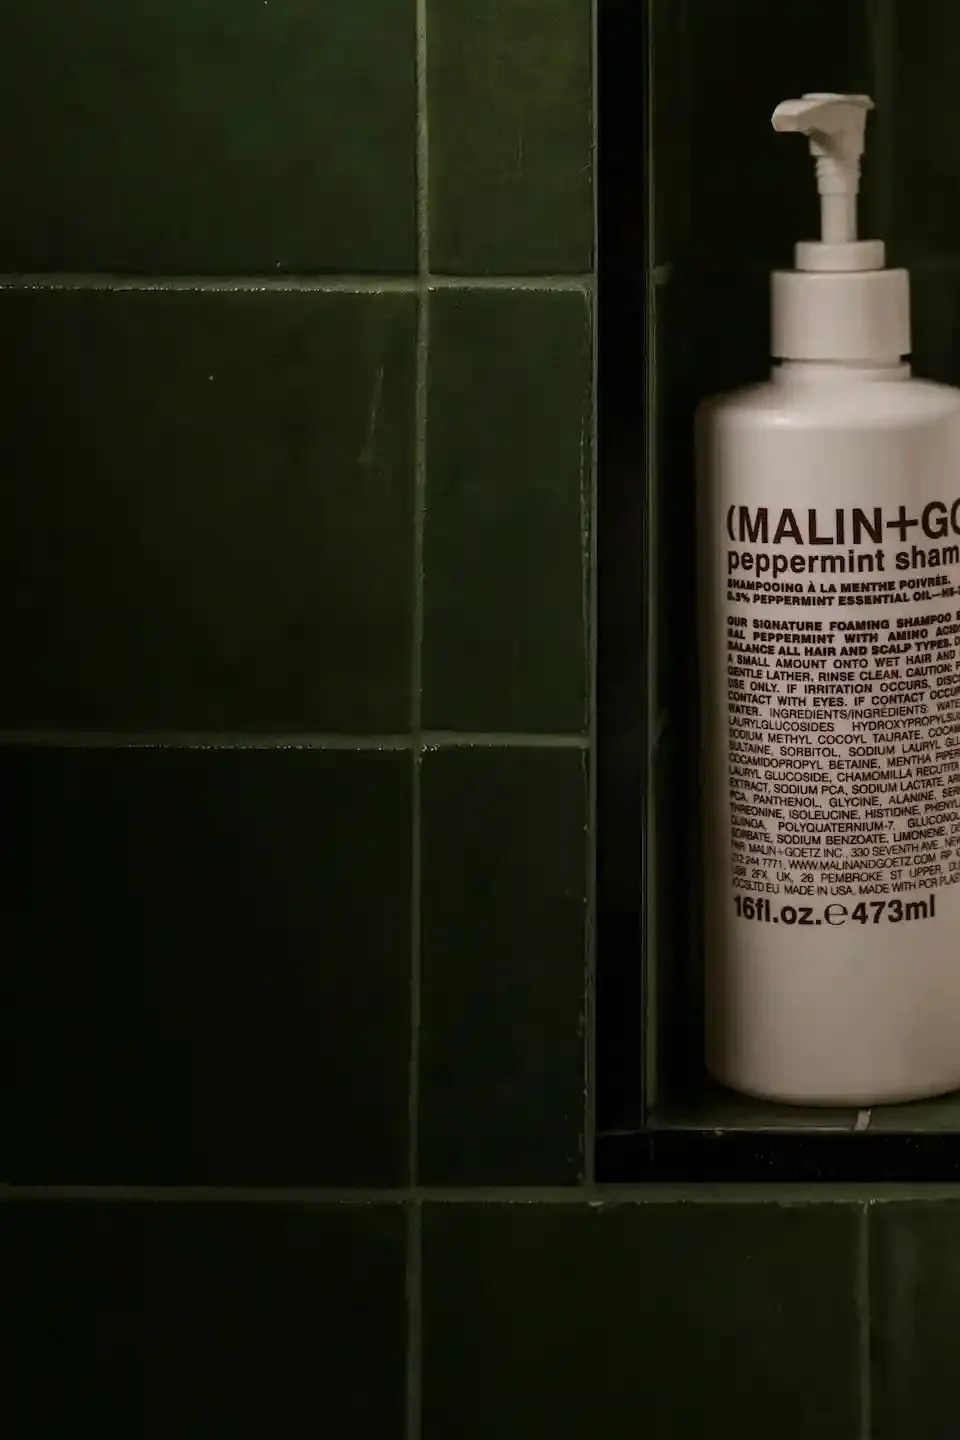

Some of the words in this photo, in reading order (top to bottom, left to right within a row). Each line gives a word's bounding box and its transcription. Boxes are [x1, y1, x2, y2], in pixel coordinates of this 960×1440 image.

[728, 549, 884, 578] peppermint
[820, 583, 837, 593] LA
[841, 581, 896, 593] MENTHE
[754, 594, 833, 607] PEPPERMINT
[839, 593, 909, 606] ESSENTIAL
[728, 616, 747, 627] OUR
[753, 619, 822, 631] SIGNATURE
[829, 620, 889, 631] FOAMING
[897, 612, 951, 628] SHAMPOO
[753, 632, 835, 644] PEPPERMINT
[845, 633, 878, 643] WITH
[888, 629, 928, 641] AMINO
[778, 646, 800, 656] ALL
[805, 646, 836, 656] HAIR
[840, 646, 868, 656] AND
[872, 643, 911, 655] SCALP
[737, 655, 770, 667] SMALL
[776, 659, 827, 669] AMOUNT
[834, 658, 868, 669] ONTO
[875, 657, 900, 667] WET
[906, 654, 931, 665] HAIR
[818, 672, 855, 681] RINSE
[860, 670, 902, 680] CLEAN.
[750, 681, 780, 693] ONLY.
[787, 684, 796, 694] IF
[804, 683, 872, 694] IRRITATION
[778, 696, 806, 707] WITH
[813, 697, 848, 707] EYES.
[855, 696, 864, 706] IF
[872, 691, 924, 705] CONTACT
[768, 732, 811, 744] METHYL
[817, 735, 867, 744] COCOYL
[849, 746, 894, 757] SODIUM
[902, 740, 941, 754] LAURYL
[887, 755, 931, 767] MENTHA
[774, 783, 817, 795] SODIUM
[851, 782, 897, 795] SODIUM
[776, 834, 820, 846] SODIUM
